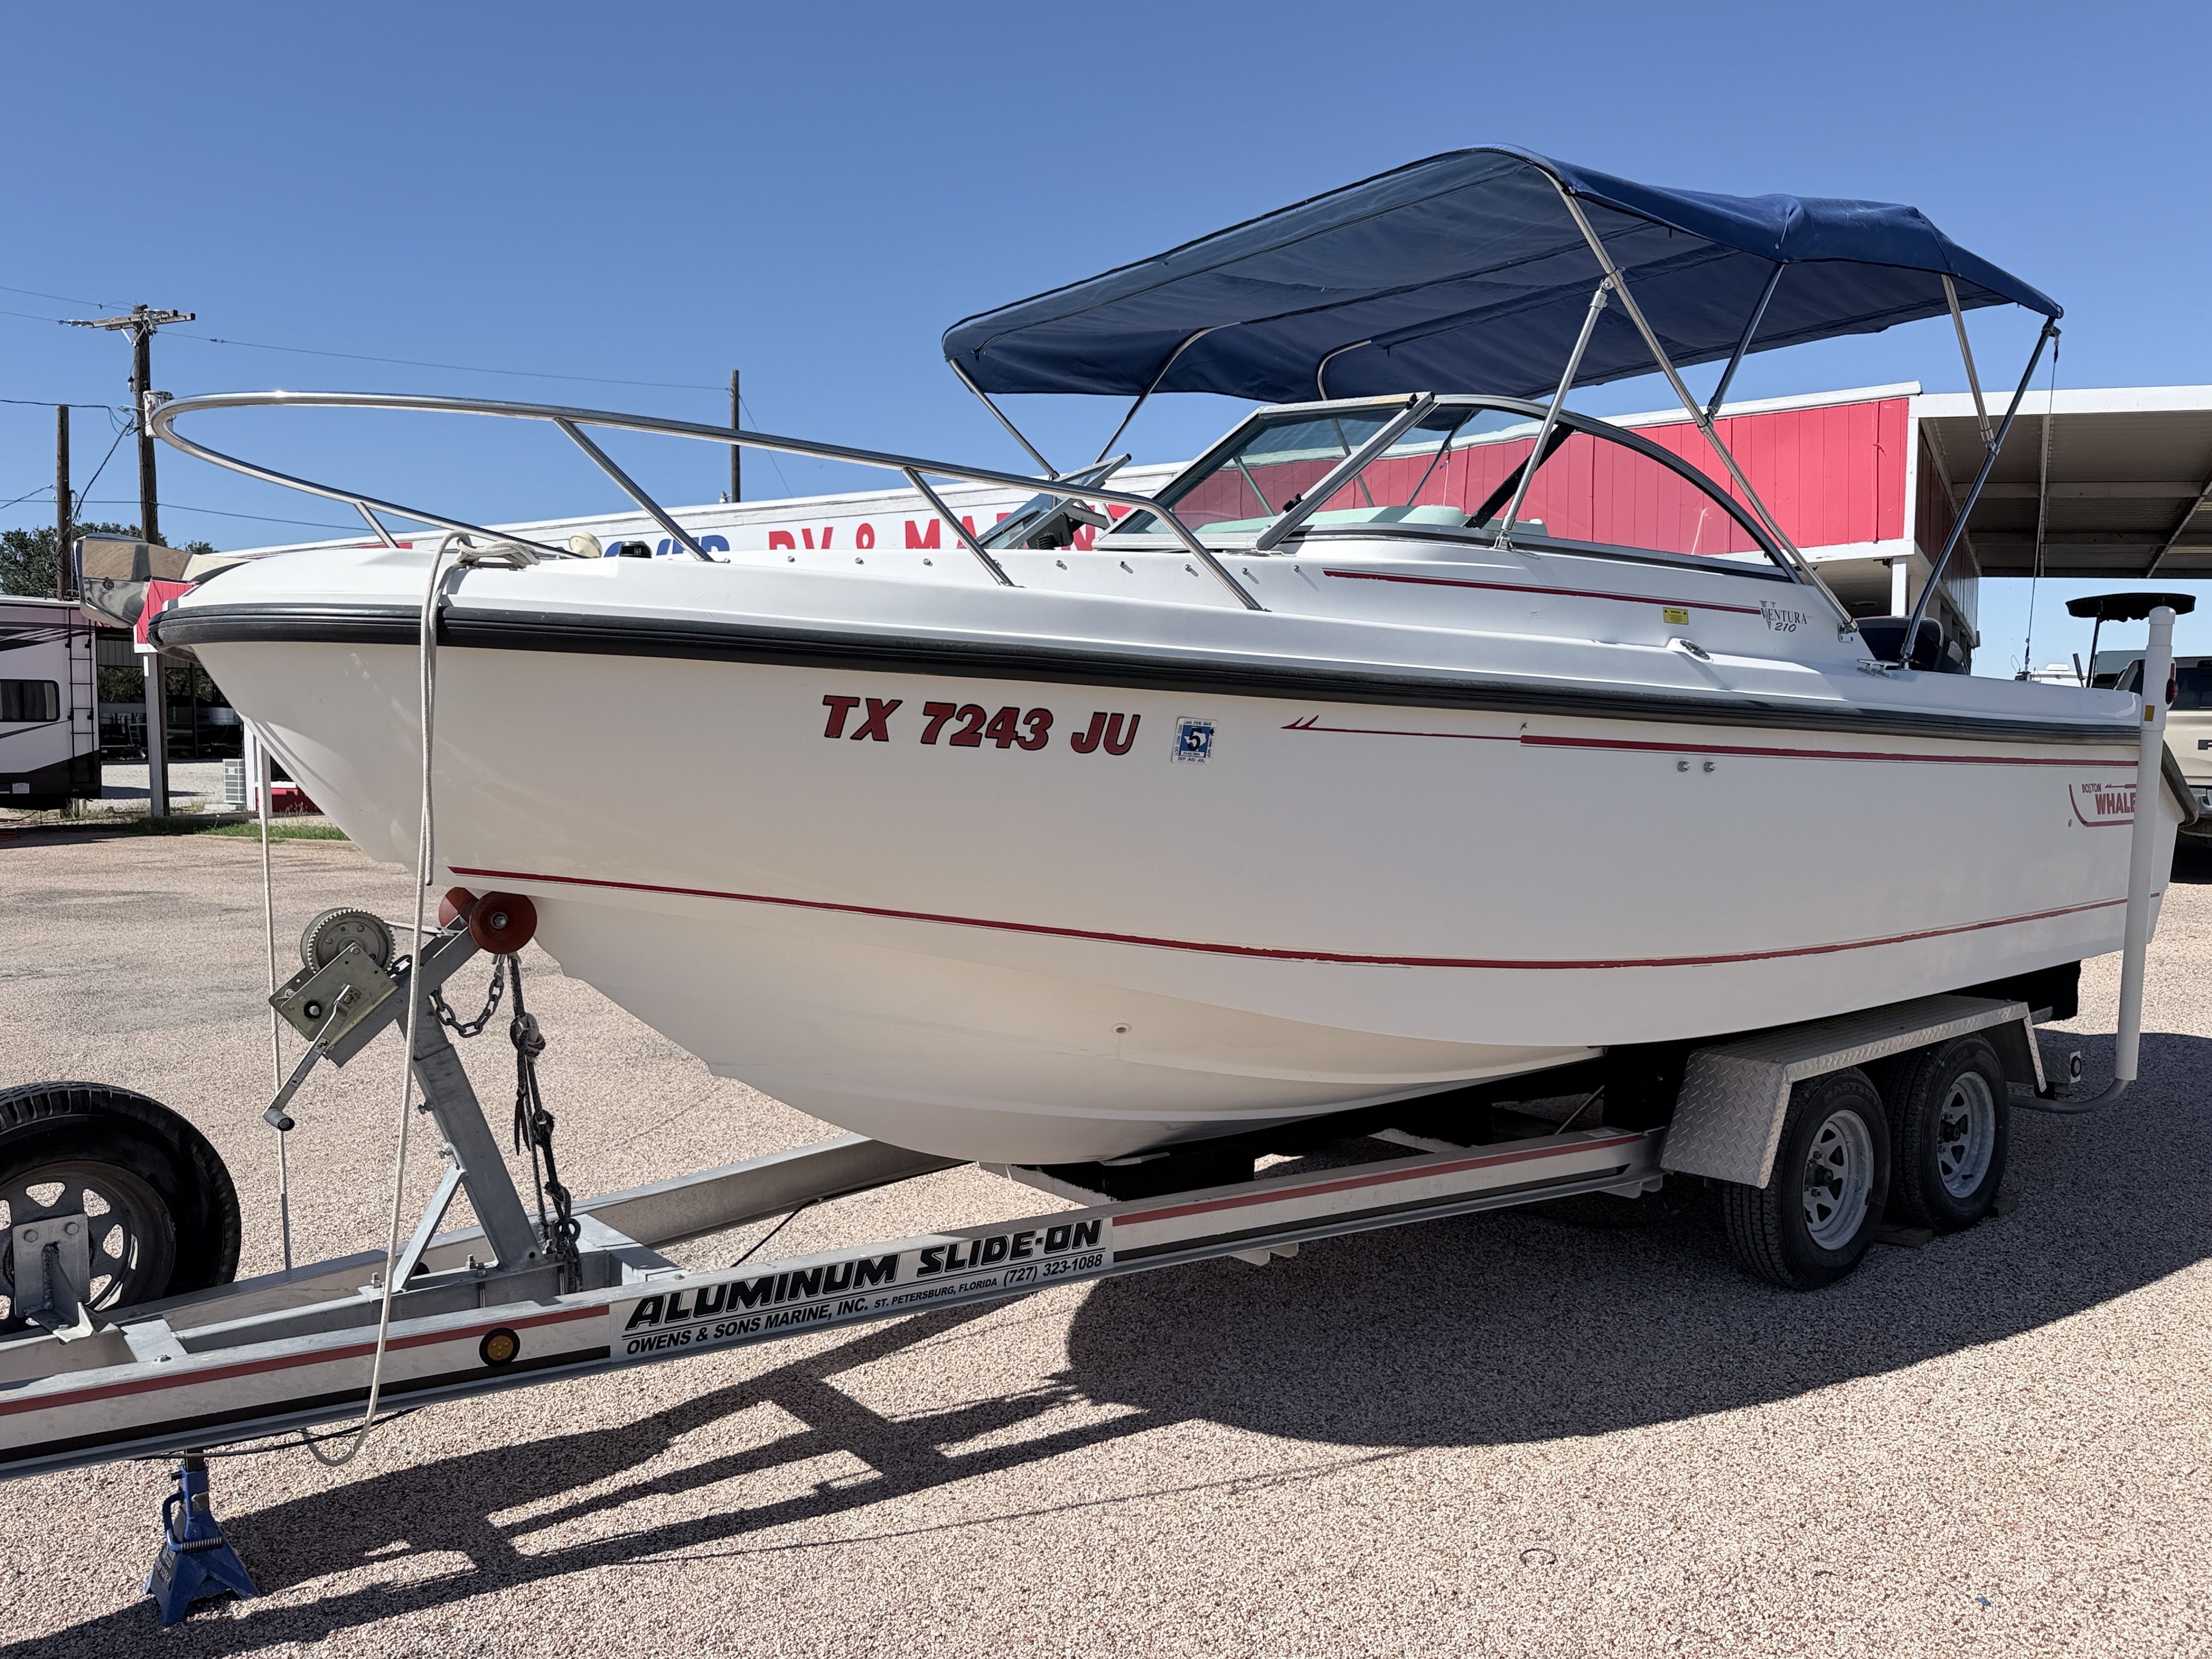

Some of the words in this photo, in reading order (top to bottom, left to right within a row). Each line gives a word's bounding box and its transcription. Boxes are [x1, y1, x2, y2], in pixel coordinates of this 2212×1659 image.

[1759, 601, 1807, 625] VENTURA
[1774, 622, 1796, 632] 210
[823, 695, 903, 742] TX
[921, 702, 1053, 751] 7243
[1070, 712, 1141, 755] JU
[1187, 727, 1201, 752] 5
[2082, 783, 2101, 793] BOSTON
[2095, 792, 2136, 815] WHALE
[625, 1254, 900, 1331] ALUMINUM
[917, 1218, 1103, 1277] SLIDE-ON
[627, 1330, 691, 1355] OWENS
[695, 1327, 708, 1342] &
[713, 1318, 761, 1339] SONS
[764, 1304, 832, 1330] MARINE,
[837, 1297, 868, 1315] INC.
[874, 1298, 889, 1308] ST.
[891, 1285, 956, 1307] PETERSBURG,
[959, 1278, 997, 1293] FLORIDA
[1003, 1266, 1037, 1287] (727)
[1042, 1254, 1103, 1277] 323-1088
